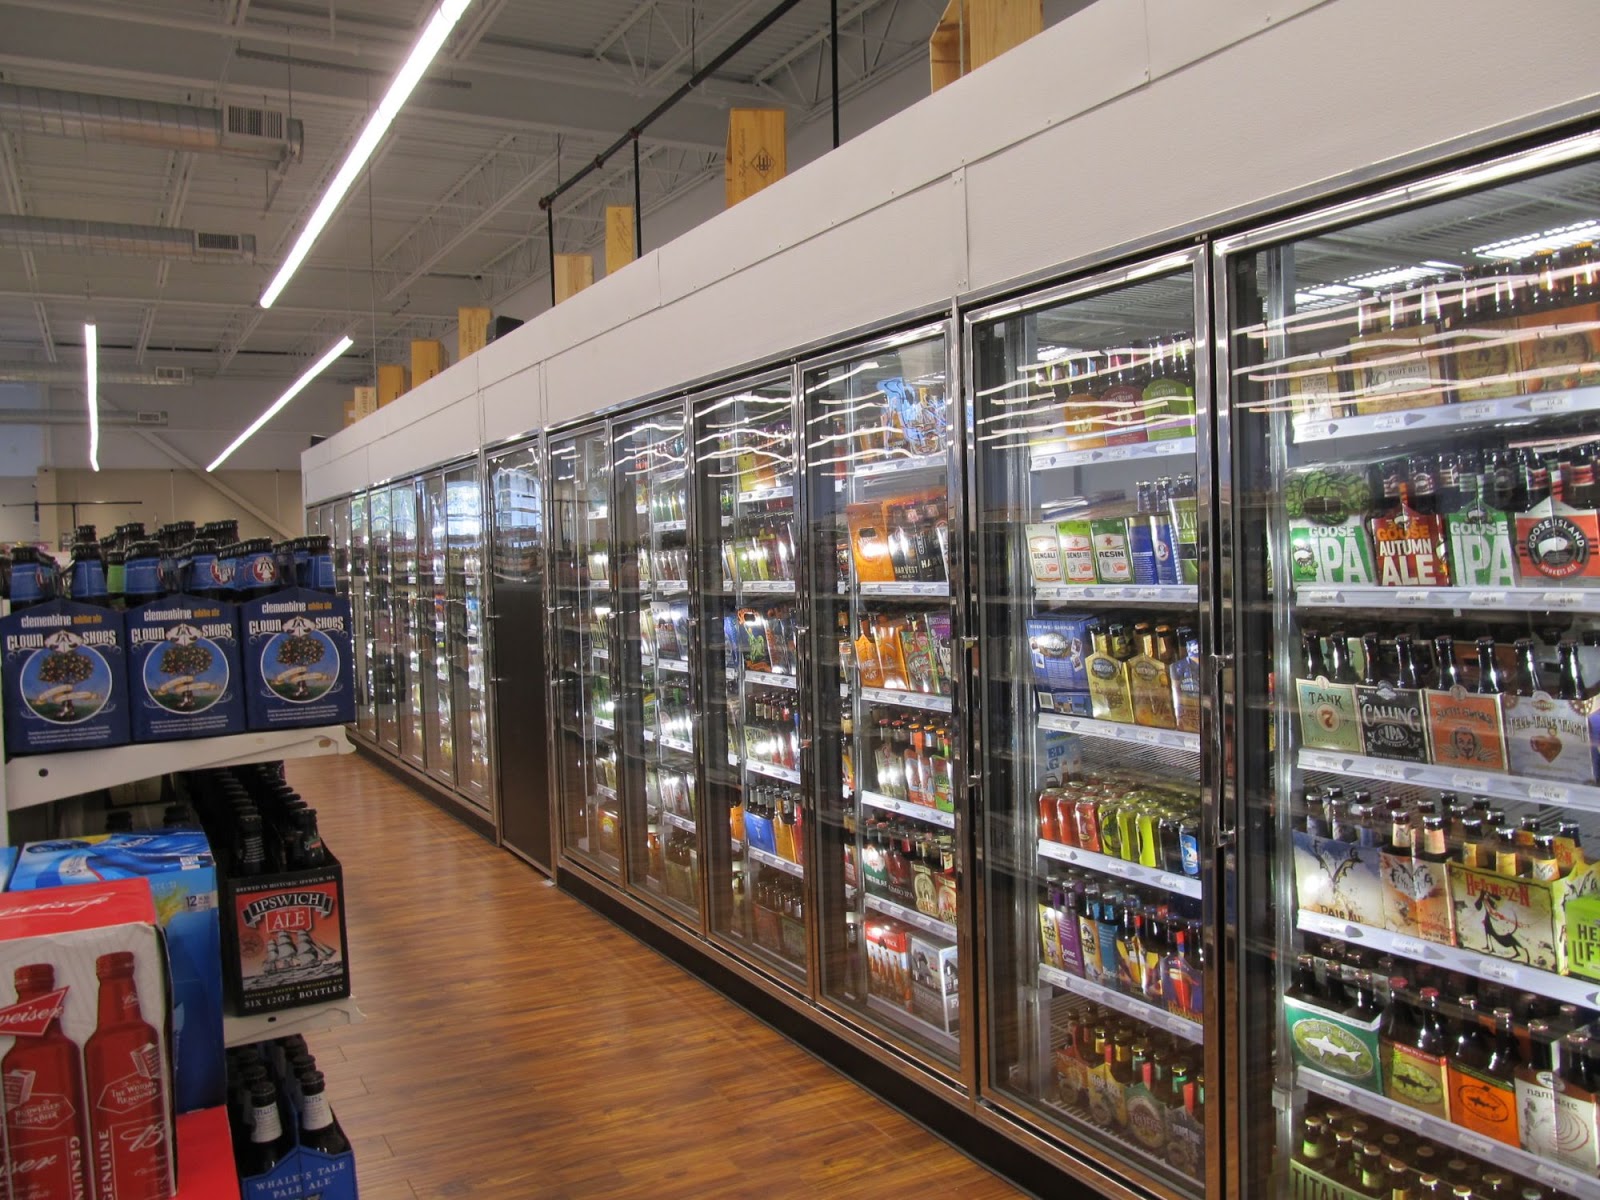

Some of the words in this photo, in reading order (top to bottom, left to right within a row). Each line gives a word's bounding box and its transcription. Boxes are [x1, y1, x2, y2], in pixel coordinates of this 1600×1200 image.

[1309, 526, 1356, 538] GOOSE
[1376, 526, 1431, 541] GOOSE
[1450, 520, 1509, 536] GOOSE
[1528, 519, 1552, 549] GOOSE
[1554, 519, 1585, 548] ISLAND
[1380, 538, 1433, 557] AUTUMN
[1311, 536, 1372, 586] IPA
[1382, 554, 1437, 586] ALE
[1451, 534, 1516, 587] IPA
[143, 608, 192, 622] clementine
[261, 601, 307, 614] clementine
[21, 614, 72, 629] clementine
[248, 619, 282, 635] CLOWN
[315, 616, 344, 631] SHOES
[7, 633, 44, 651] CLOWN
[82, 630, 117, 646] SHOES
[131, 627, 165, 644] CLOWN
[201, 623, 233, 638] SHOES
[1308, 691, 1345, 712] TANK
[1362, 703, 1421, 733] CALLING
[1383, 724, 1405, 742] IPA
[1558, 717, 1587, 743] TART
[186, 895, 198, 908] 12
[252, 893, 320, 915] IPSWICH
[272, 911, 306, 930] ALE
[244, 1000, 262, 1009] SIX
[299, 984, 344, 999] BOTTLES
[1337, 1030, 1361, 1050] Head
[255, 1172, 313, 1191] WHALE'S
[317, 1161, 346, 1177] TALE
[273, 1186, 303, 1199] PALE
[308, 1178, 332, 1191] ALE
